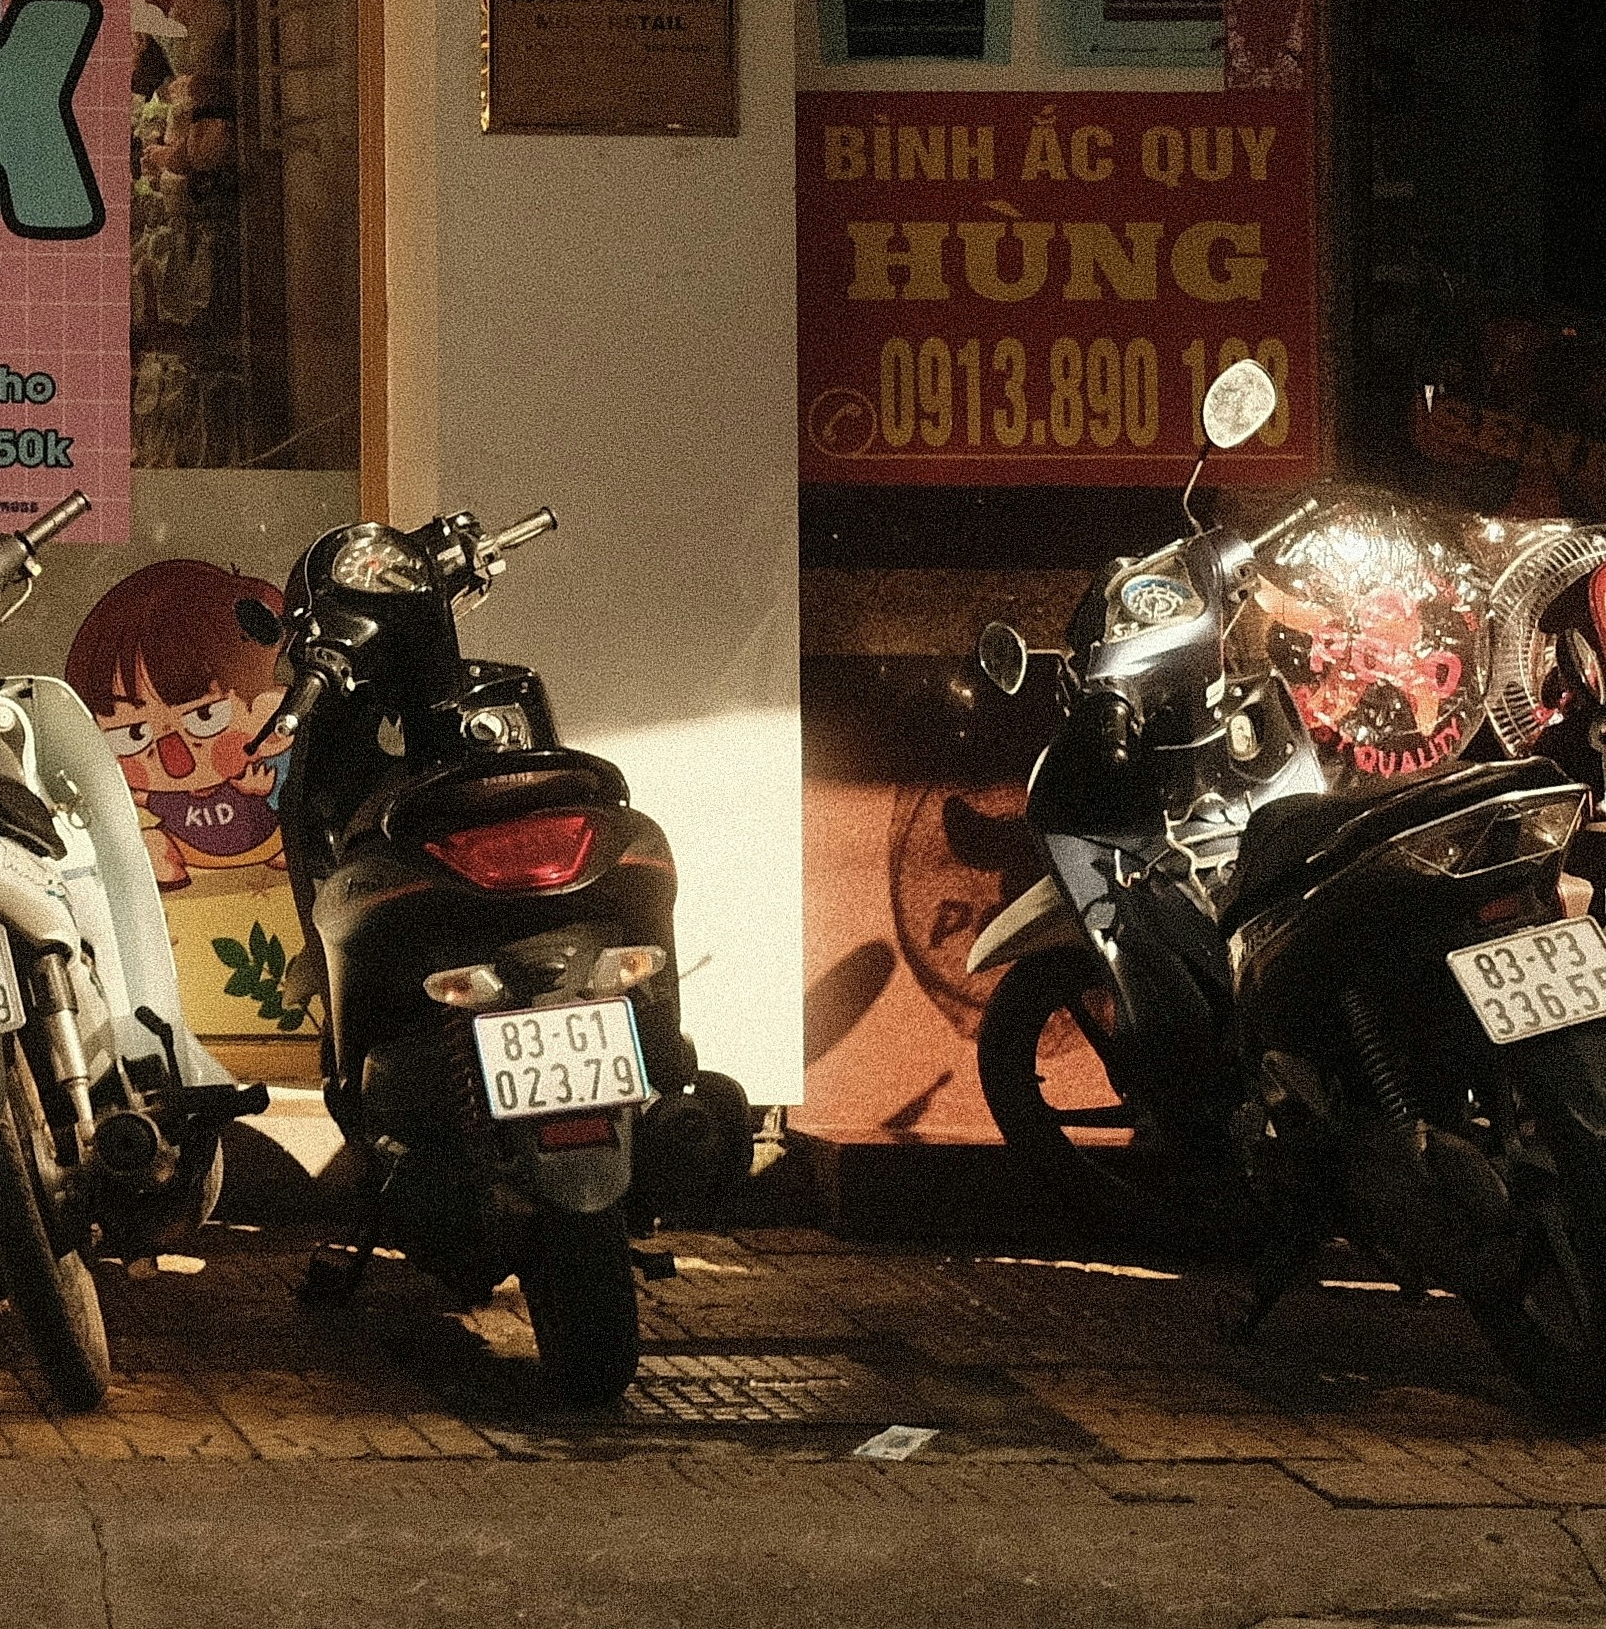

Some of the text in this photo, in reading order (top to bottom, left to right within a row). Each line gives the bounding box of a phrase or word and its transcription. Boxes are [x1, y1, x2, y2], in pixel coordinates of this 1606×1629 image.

[824, 114, 995, 181] BÌNH
[1141, 125, 1277, 188] QUY
[846, 200, 1270, 303] HÙNG
[879, 337, 1160, 448] 0913.890
[185, 802, 234, 827] KID
[1474, 930, 1587, 990] 83-P3
[495, 1055, 635, 1111] 023.79
